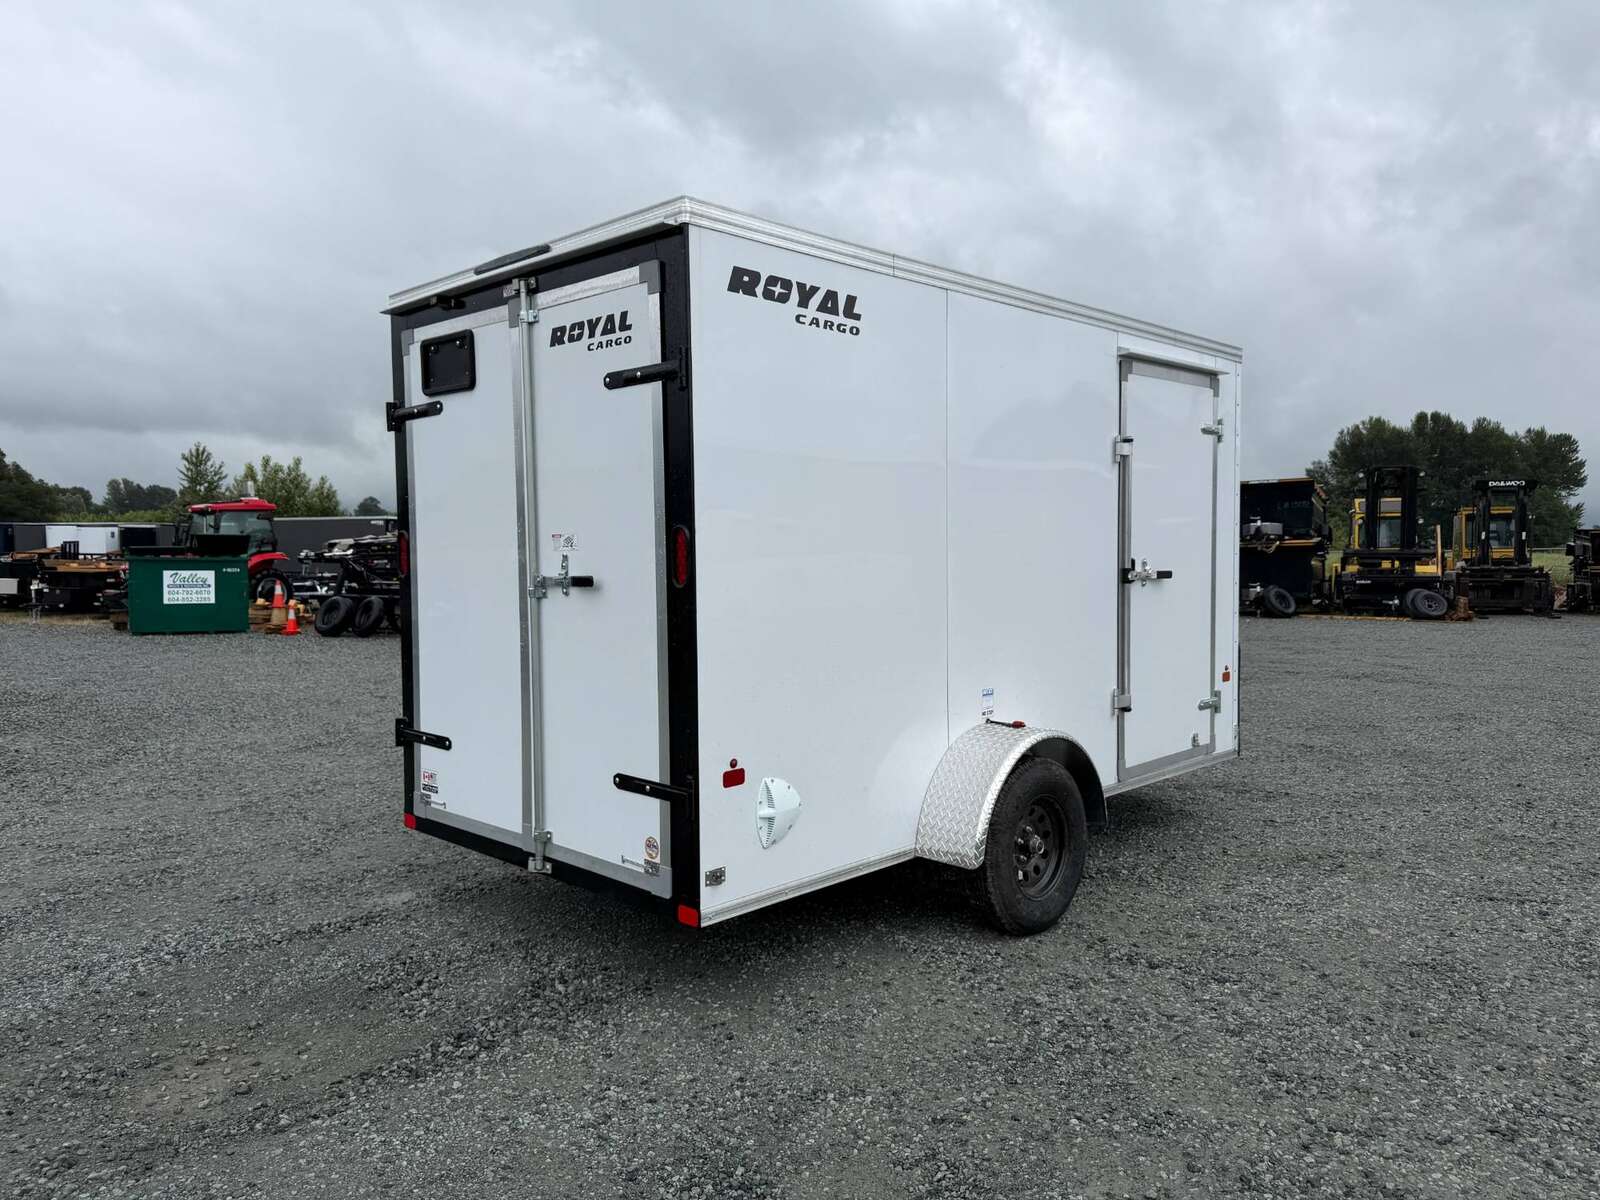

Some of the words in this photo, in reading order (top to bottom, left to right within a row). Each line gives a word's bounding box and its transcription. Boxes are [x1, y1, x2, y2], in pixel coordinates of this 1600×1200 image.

[727, 265, 862, 321] ROYAL
[549, 310, 633, 348] ROYAL
[795, 313, 861, 336] CARGO
[587, 335, 632, 352] CARGO
[169, 572, 209, 584] Valley
